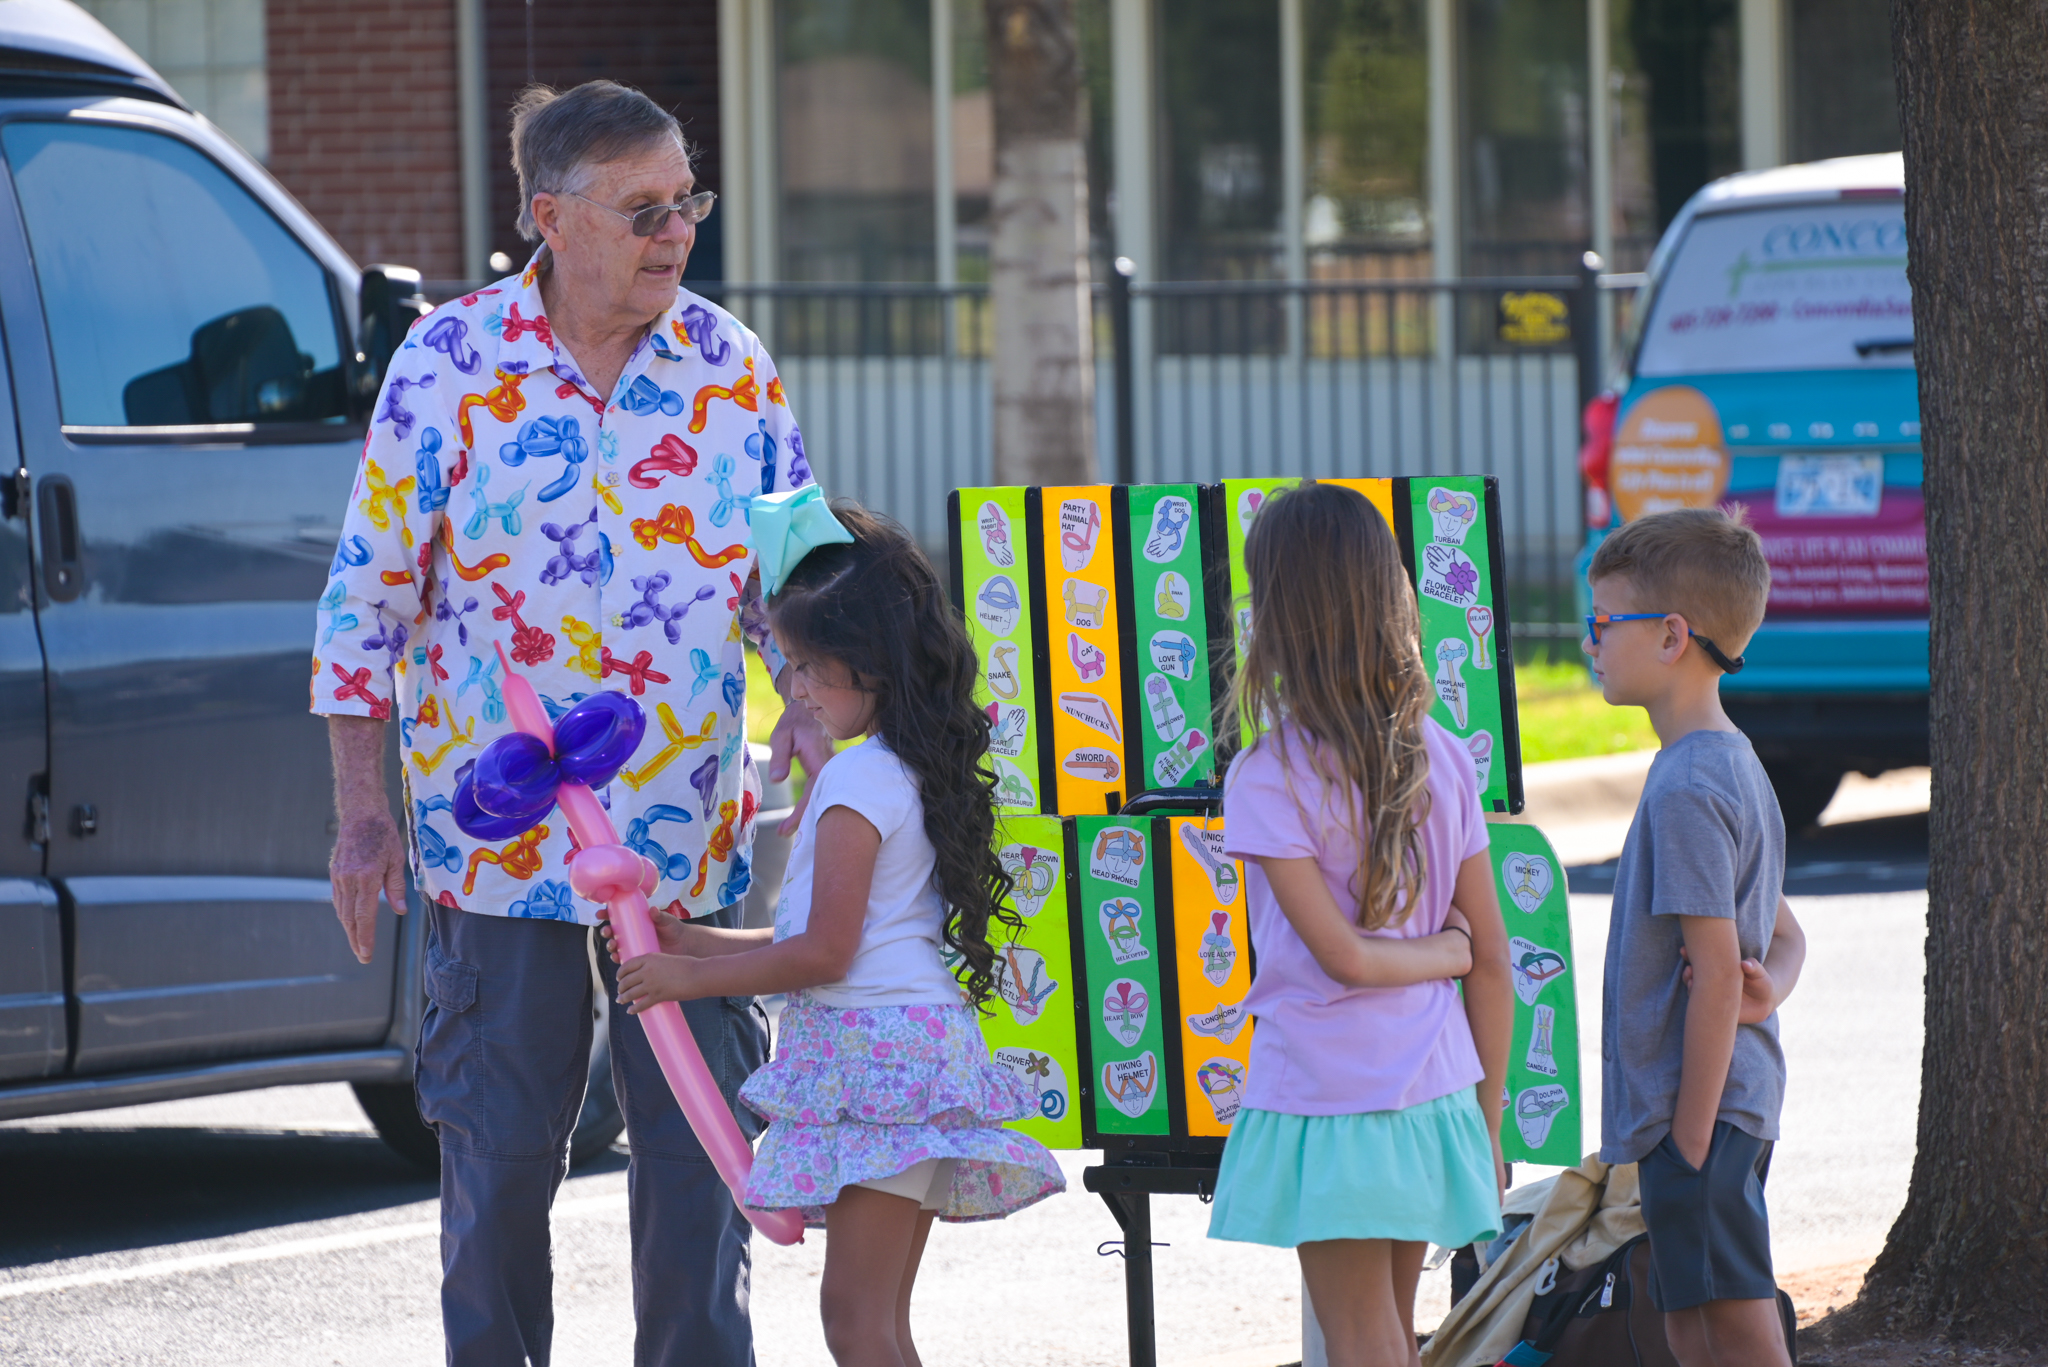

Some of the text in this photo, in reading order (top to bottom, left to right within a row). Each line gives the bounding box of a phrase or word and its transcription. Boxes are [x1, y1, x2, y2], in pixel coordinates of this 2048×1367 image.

[1063, 503, 1086, 514] PARTY
[1062, 513, 1088, 525] ANIMAL
[1062, 523, 1075, 531] HAT
[1435, 536, 1460, 544] TURBAN
[1426, 579, 1456, 595] FLOWER
[1424, 587, 1463, 604] BRACELET
[980, 612, 1002, 622] HELMET
[1081, 646, 1093, 656] CAT
[1158, 655, 1175, 663] LOVE
[988, 671, 1011, 679] SNAKE
[1437, 678, 1466, 688] AIRPLANE
[1442, 694, 1459, 702] STICK
[1065, 706, 1110, 730] NUNCHUCKS
[1156, 714, 1184, 730] SUNFLOWER
[1075, 753, 1104, 762] SWORD
[1164, 757, 1179, 776] HEART
[1158, 760, 1178, 785] FLOWER
[1211, 845, 1224, 854] HA
[1001, 852, 1058, 863] HEART CROWN
[1515, 865, 1540, 877] MICKEY
[1091, 868, 1138, 887] HEAD PHONES
[1512, 939, 1537, 952] ARCHER
[1115, 950, 1148, 963] HELICOPTER
[1104, 1014, 1123, 1022] HEART
[1201, 1008, 1237, 1026] LONGHORN
[997, 1052, 1030, 1067] FLOWER
[1115, 1060, 1142, 1071] VIKING
[1526, 1062, 1547, 1073] CANDLE
[1118, 1069, 1149, 1081] HELMET
[1539, 1088, 1563, 1099] DOLPHIN
